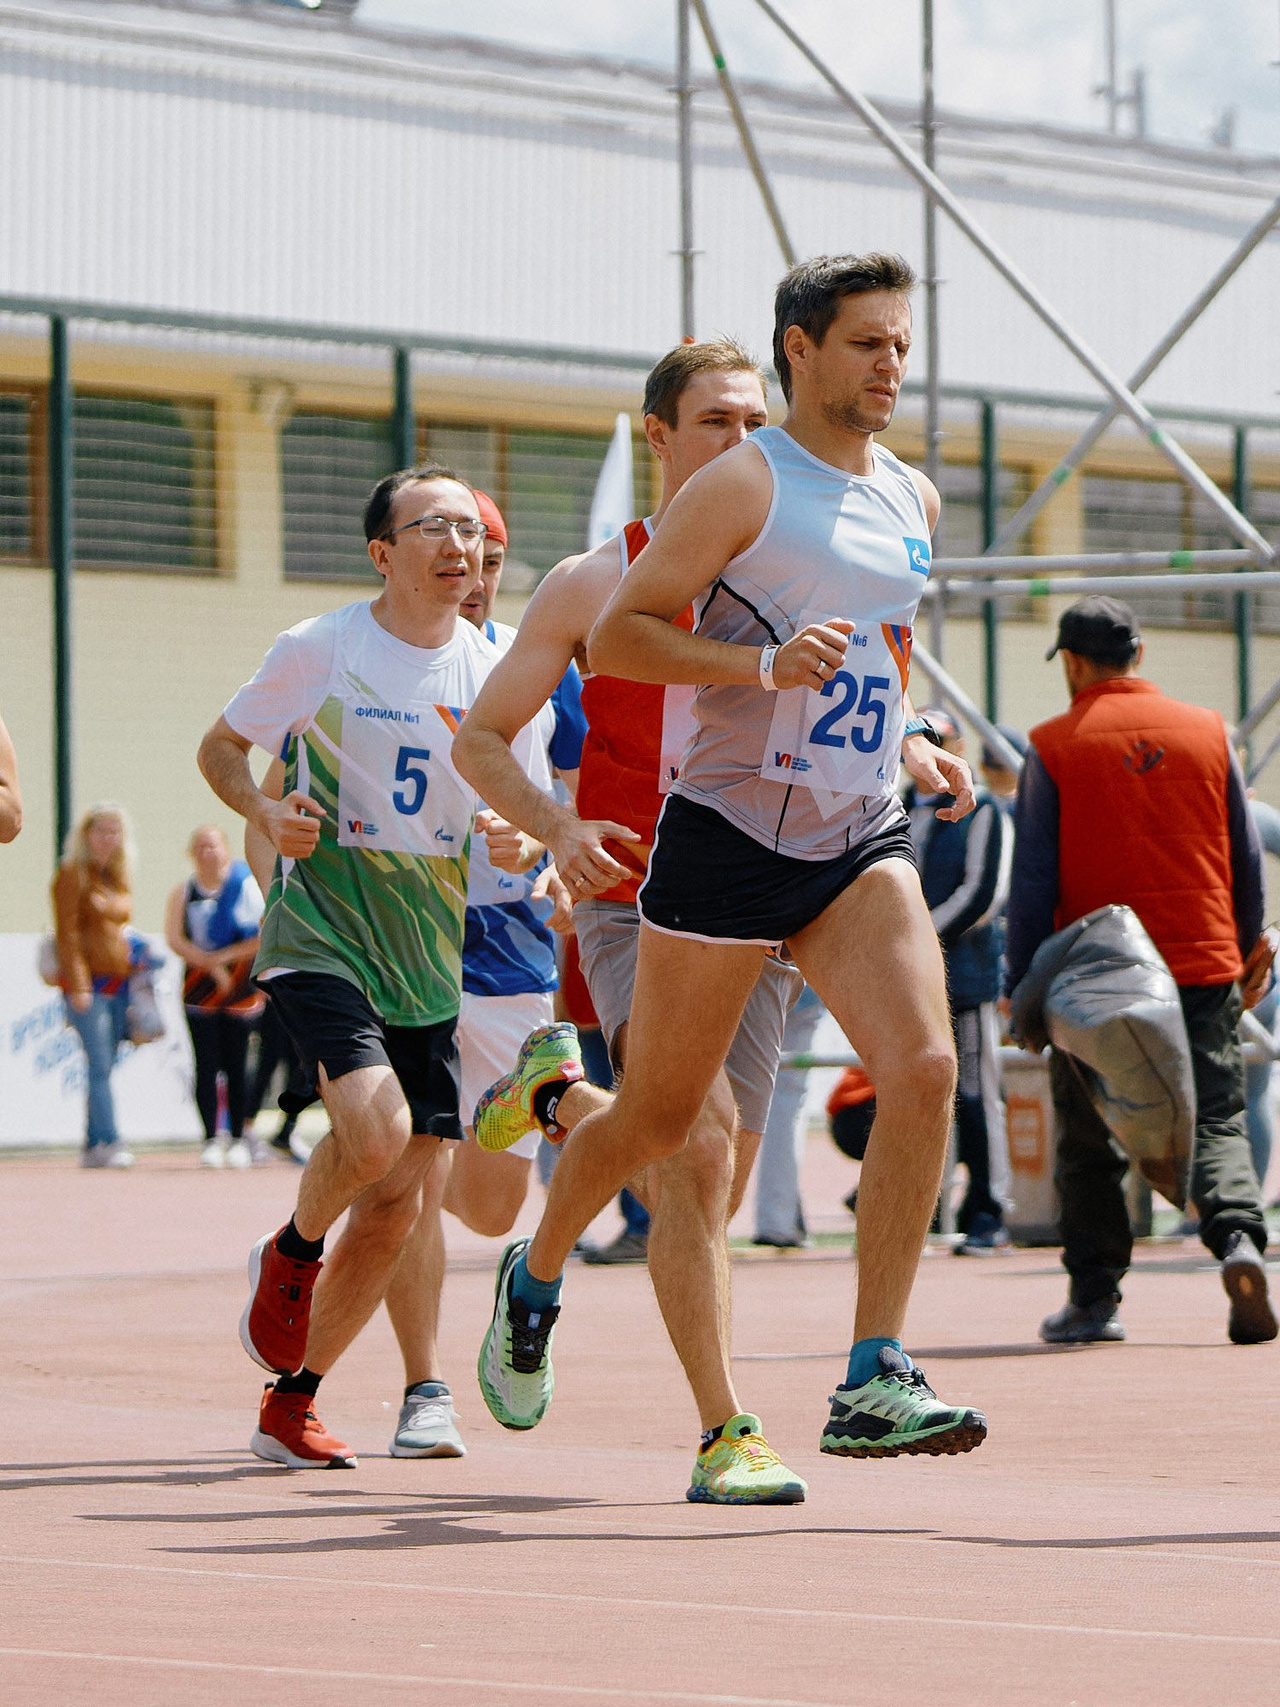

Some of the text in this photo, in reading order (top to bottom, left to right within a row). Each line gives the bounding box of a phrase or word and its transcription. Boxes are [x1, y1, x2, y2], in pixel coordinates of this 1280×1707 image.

[852, 633, 868, 647] №6
[355, 706, 420, 724] ФИЛИАЛ №1
[809, 670, 890, 753] 25
[392, 745, 430, 816] 5
